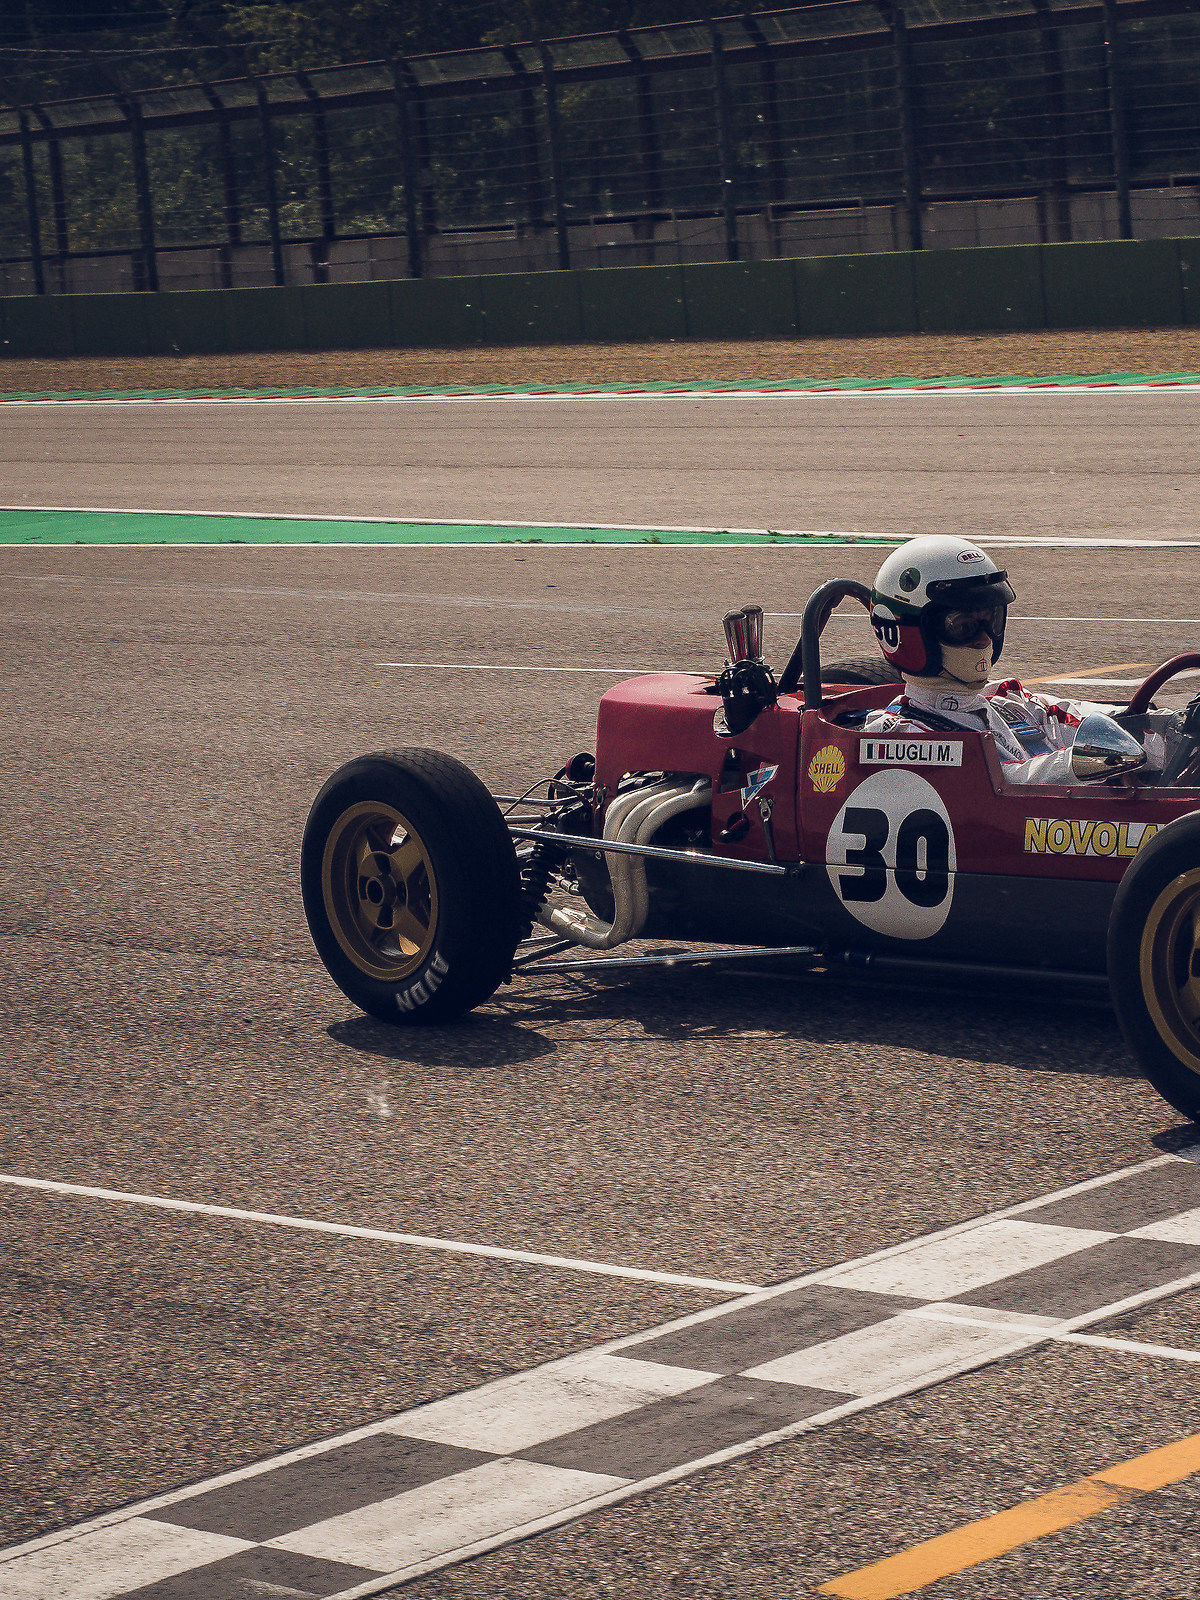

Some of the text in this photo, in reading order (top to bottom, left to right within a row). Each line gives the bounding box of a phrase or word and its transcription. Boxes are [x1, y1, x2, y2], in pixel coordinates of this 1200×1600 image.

[961, 552, 983, 561] BELL
[886, 744, 954, 762] LUGLI M.
[813, 762, 840, 775] SHELL
[838, 806, 949, 908] 30
[395, 950, 449, 1013] AVON
